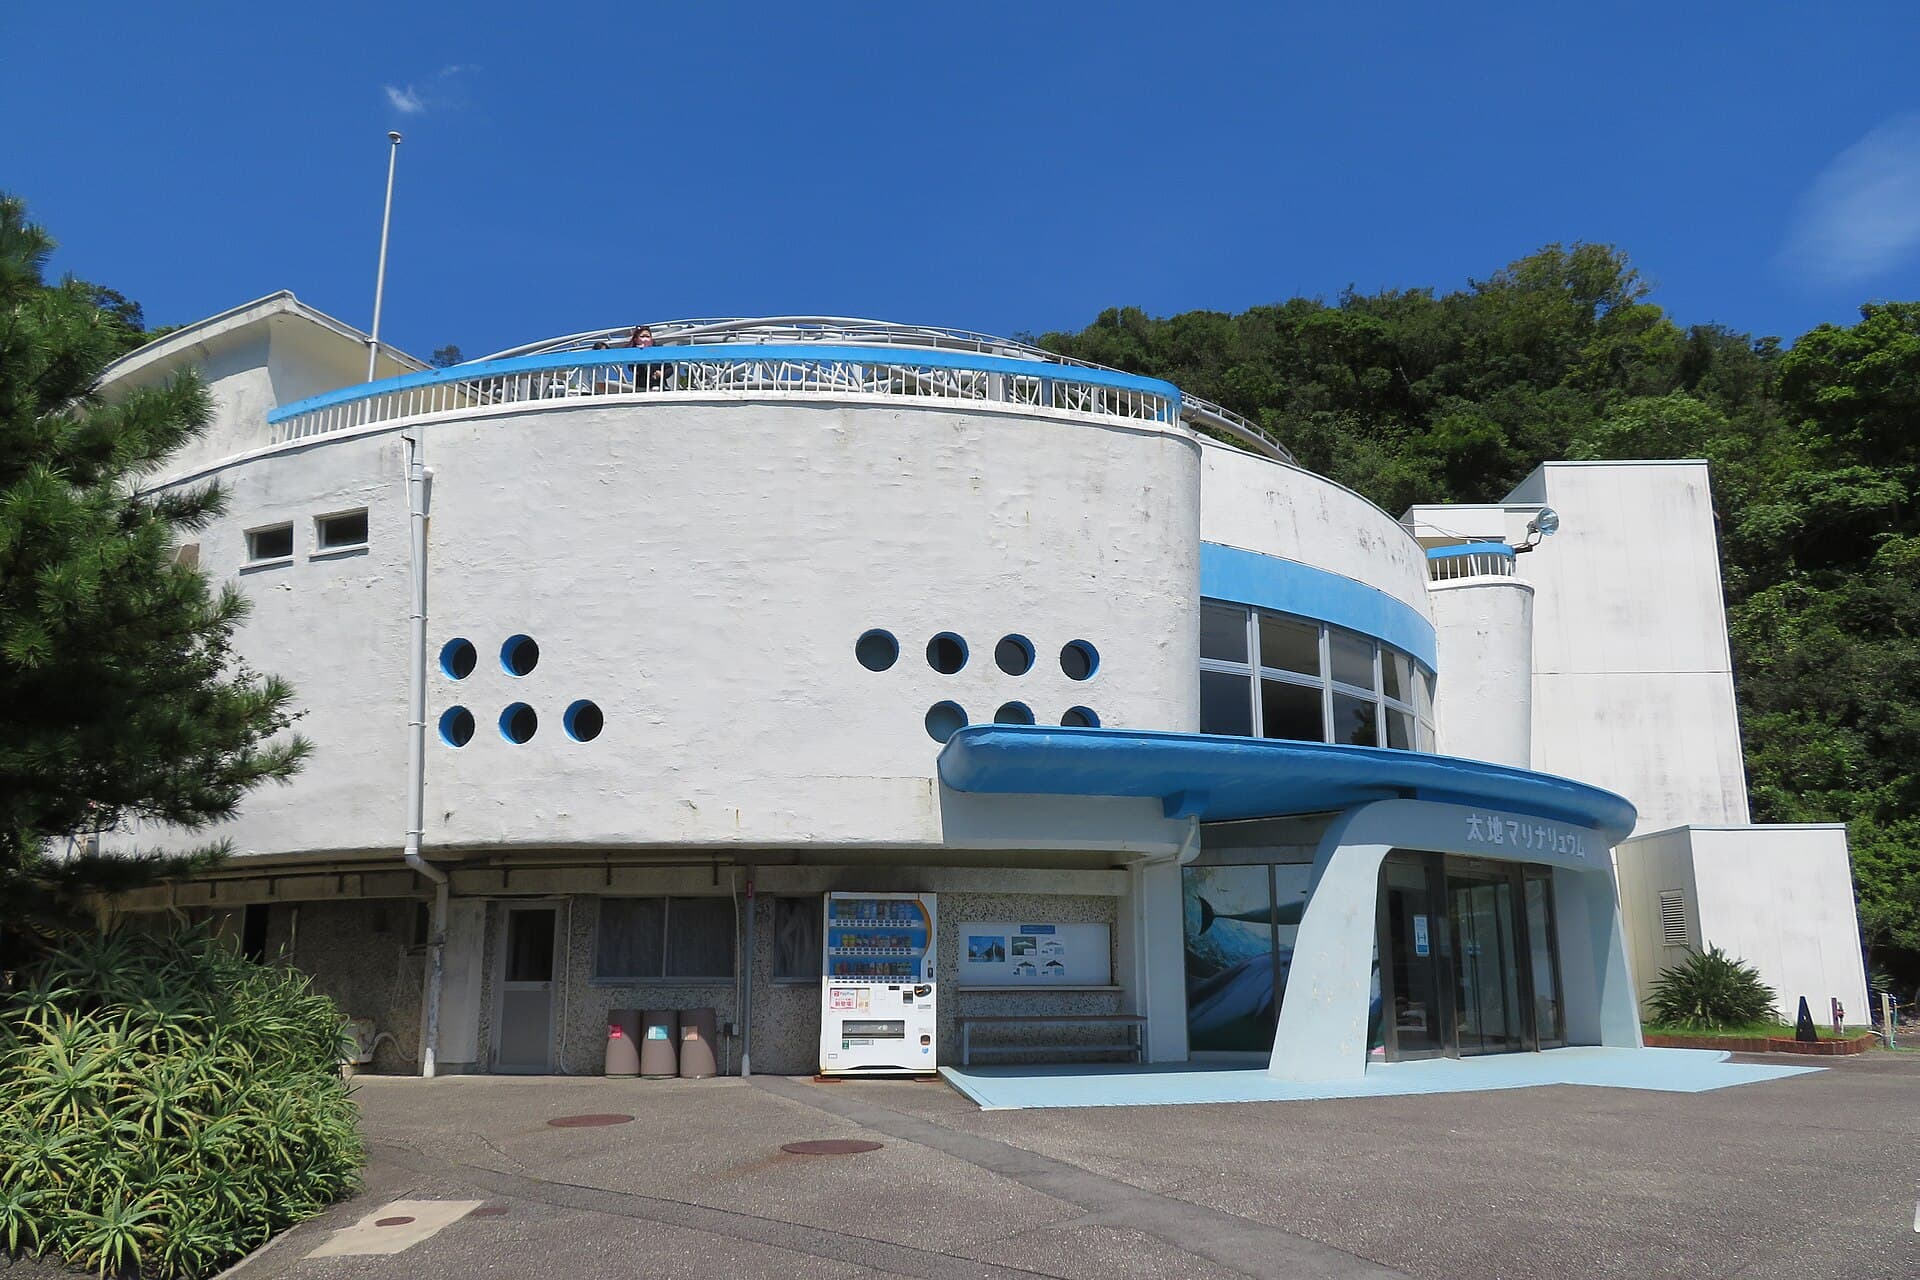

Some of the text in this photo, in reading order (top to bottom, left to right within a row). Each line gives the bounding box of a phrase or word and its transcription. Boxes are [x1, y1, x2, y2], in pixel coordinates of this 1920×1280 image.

[1466, 813, 1585, 858] 太地マリナリュウム
